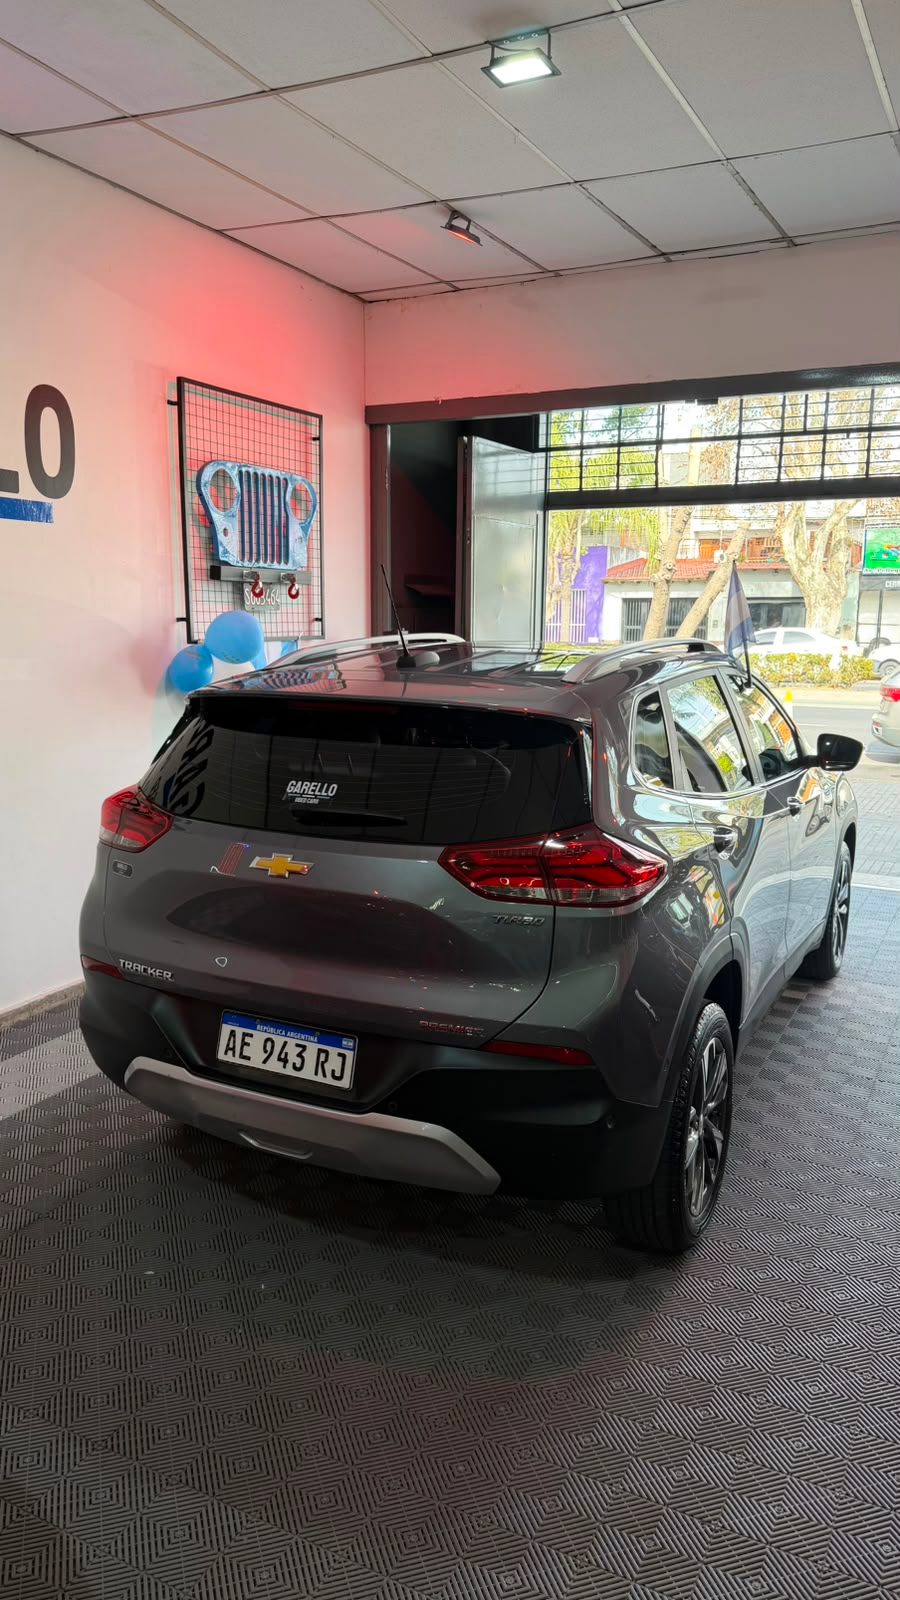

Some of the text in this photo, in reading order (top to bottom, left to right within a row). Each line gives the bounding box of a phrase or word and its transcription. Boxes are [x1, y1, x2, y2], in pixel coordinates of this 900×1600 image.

[286, 780, 338, 796] GARELLO
[119, 958, 175, 982] TRACKER
[256, 1024, 318, 1043] REPÚBLICA ARGENTINA
[224, 1029, 347, 1081] AE 943 RJ
